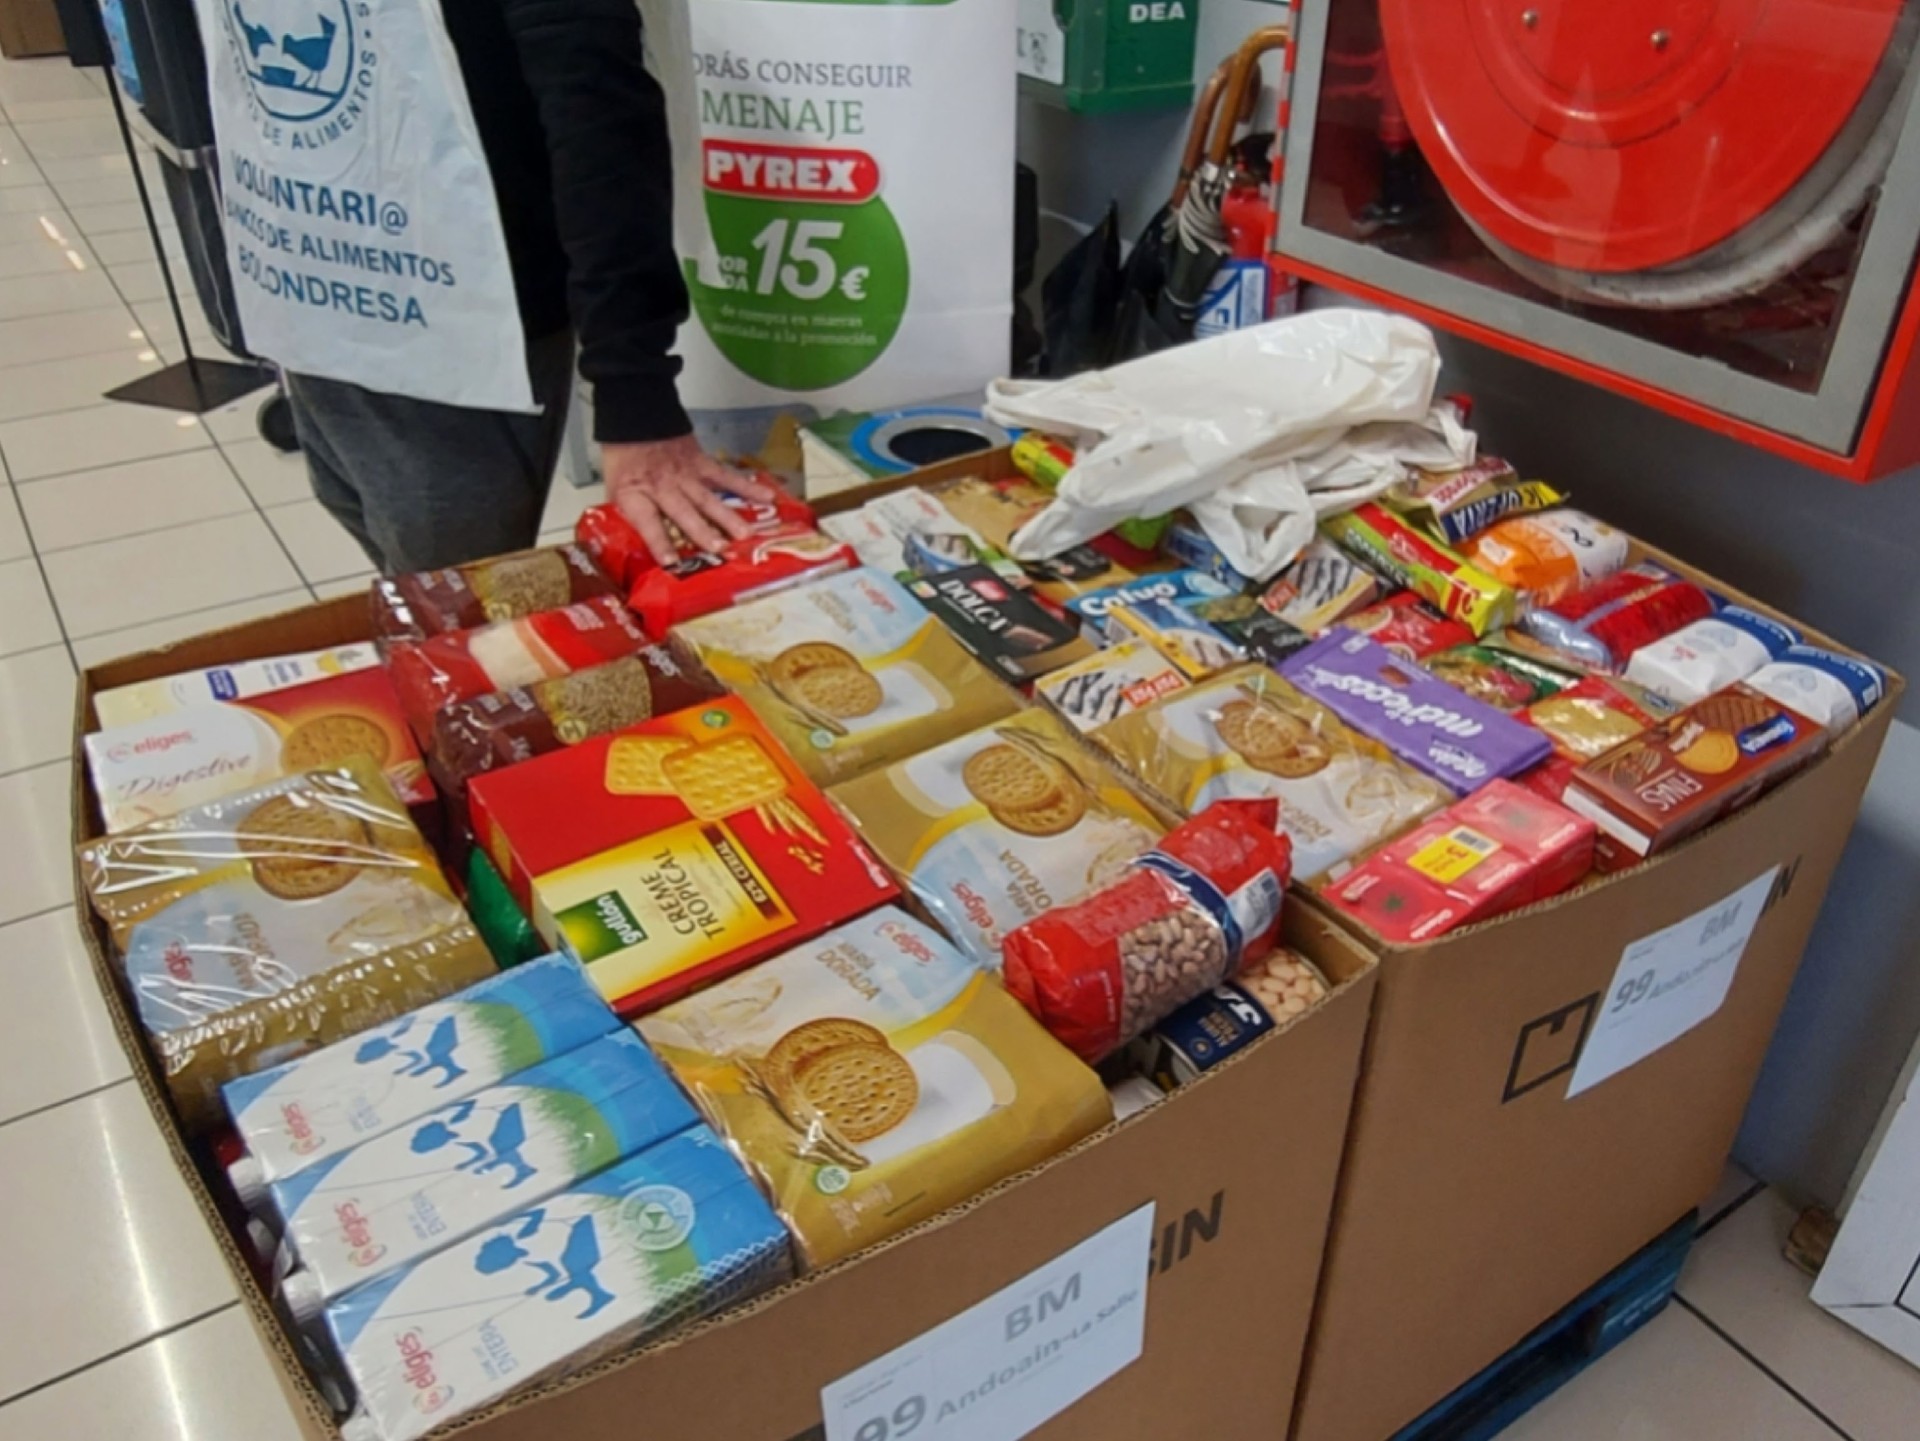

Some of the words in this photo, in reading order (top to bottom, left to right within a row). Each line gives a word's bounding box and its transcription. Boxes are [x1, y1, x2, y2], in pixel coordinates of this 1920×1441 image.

[1129, 2, 1186, 23] DEA
[292, 50, 377, 149] ALIMENTOS
[757, 60, 912, 89] CONSEGUIR
[701, 89, 865, 141] MENAJE
[707, 149, 858, 193] PYREX
[300, 233, 456, 287] ALIMENTOS
[118, 753, 252, 798] Digestive
[641, 870, 696, 935] CREME
[653, 848, 725, 940] TROPICAL
[998, 849, 1053, 909] ORADA
[598, 894, 643, 945] gullón
[1611, 969, 1656, 1013] 99
[1149, 1188, 1225, 1279] IN
[1004, 1272, 1082, 1343] BM
[397, 1332, 438, 1391] eliges
